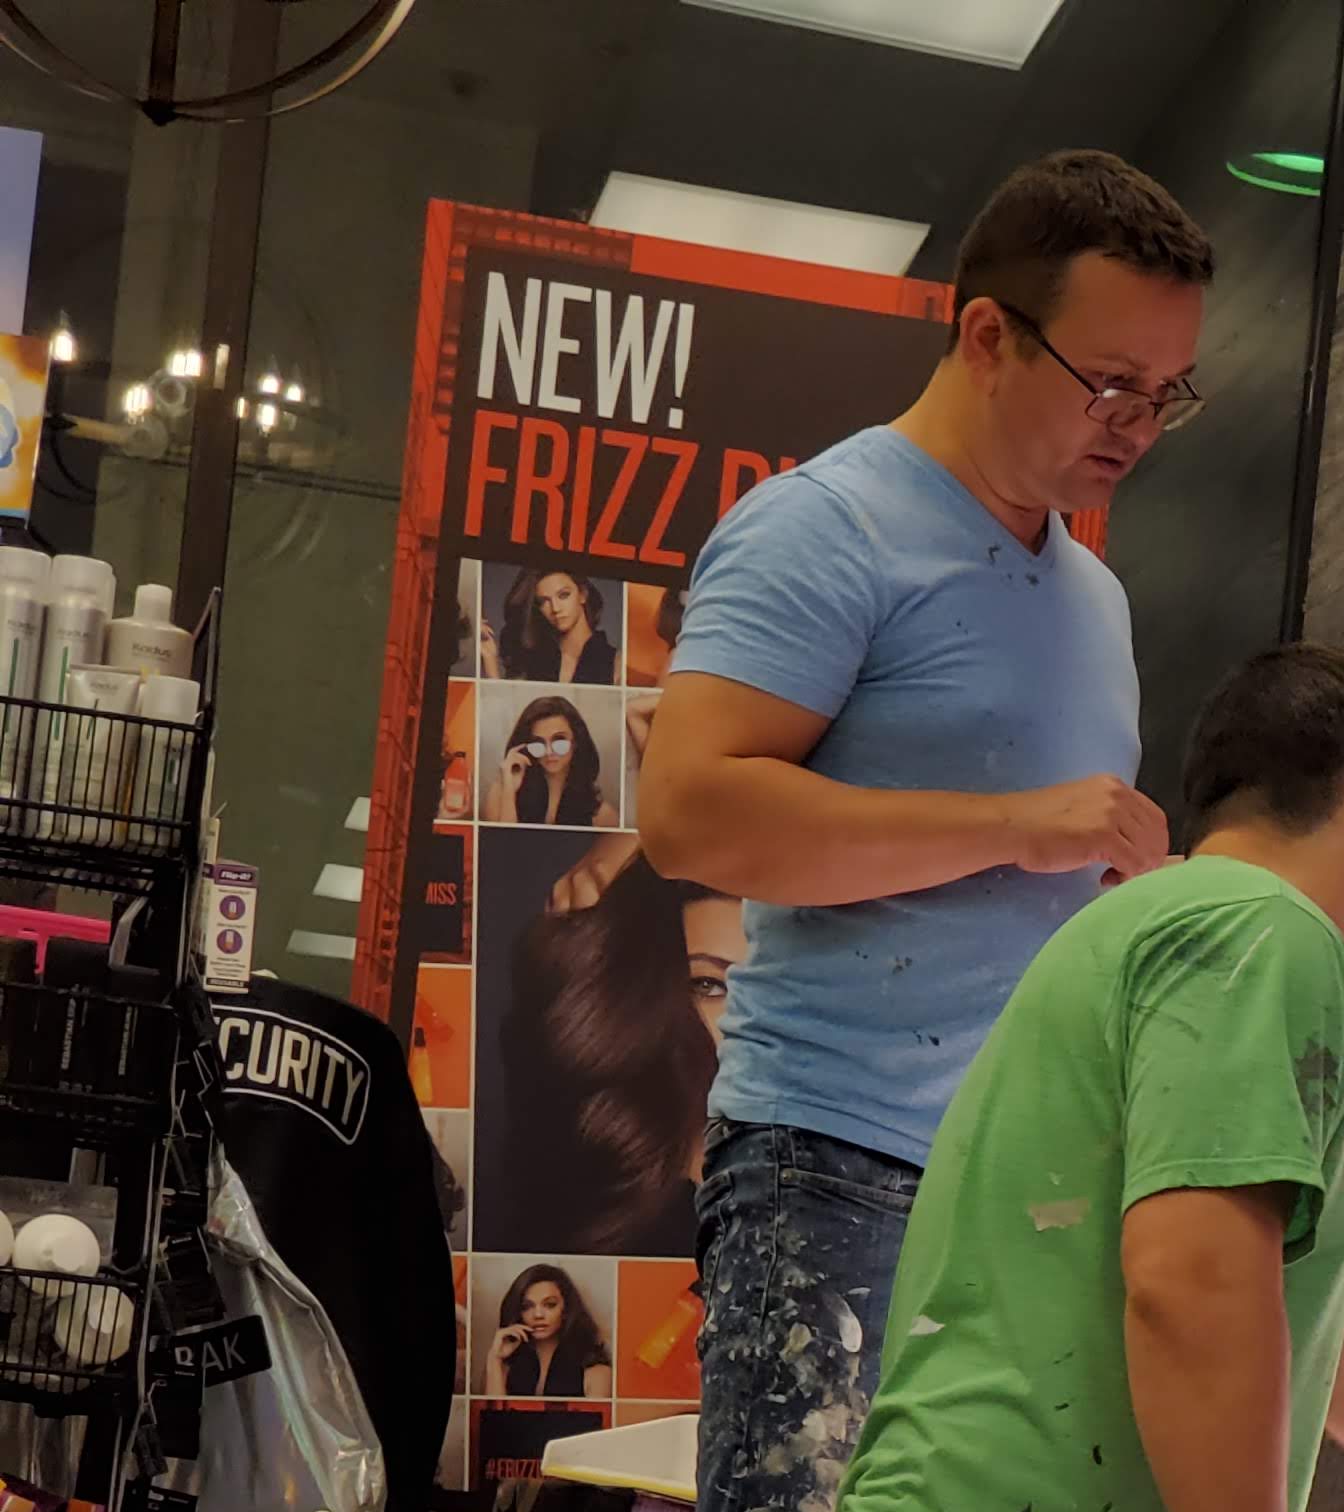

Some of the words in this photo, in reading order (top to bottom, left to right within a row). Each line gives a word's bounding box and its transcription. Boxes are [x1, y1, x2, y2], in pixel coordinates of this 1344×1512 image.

[477, 271, 695, 430] NEW!
[464, 409, 699, 568] FRIZZ
[213, 1016, 364, 1126] CURITY
